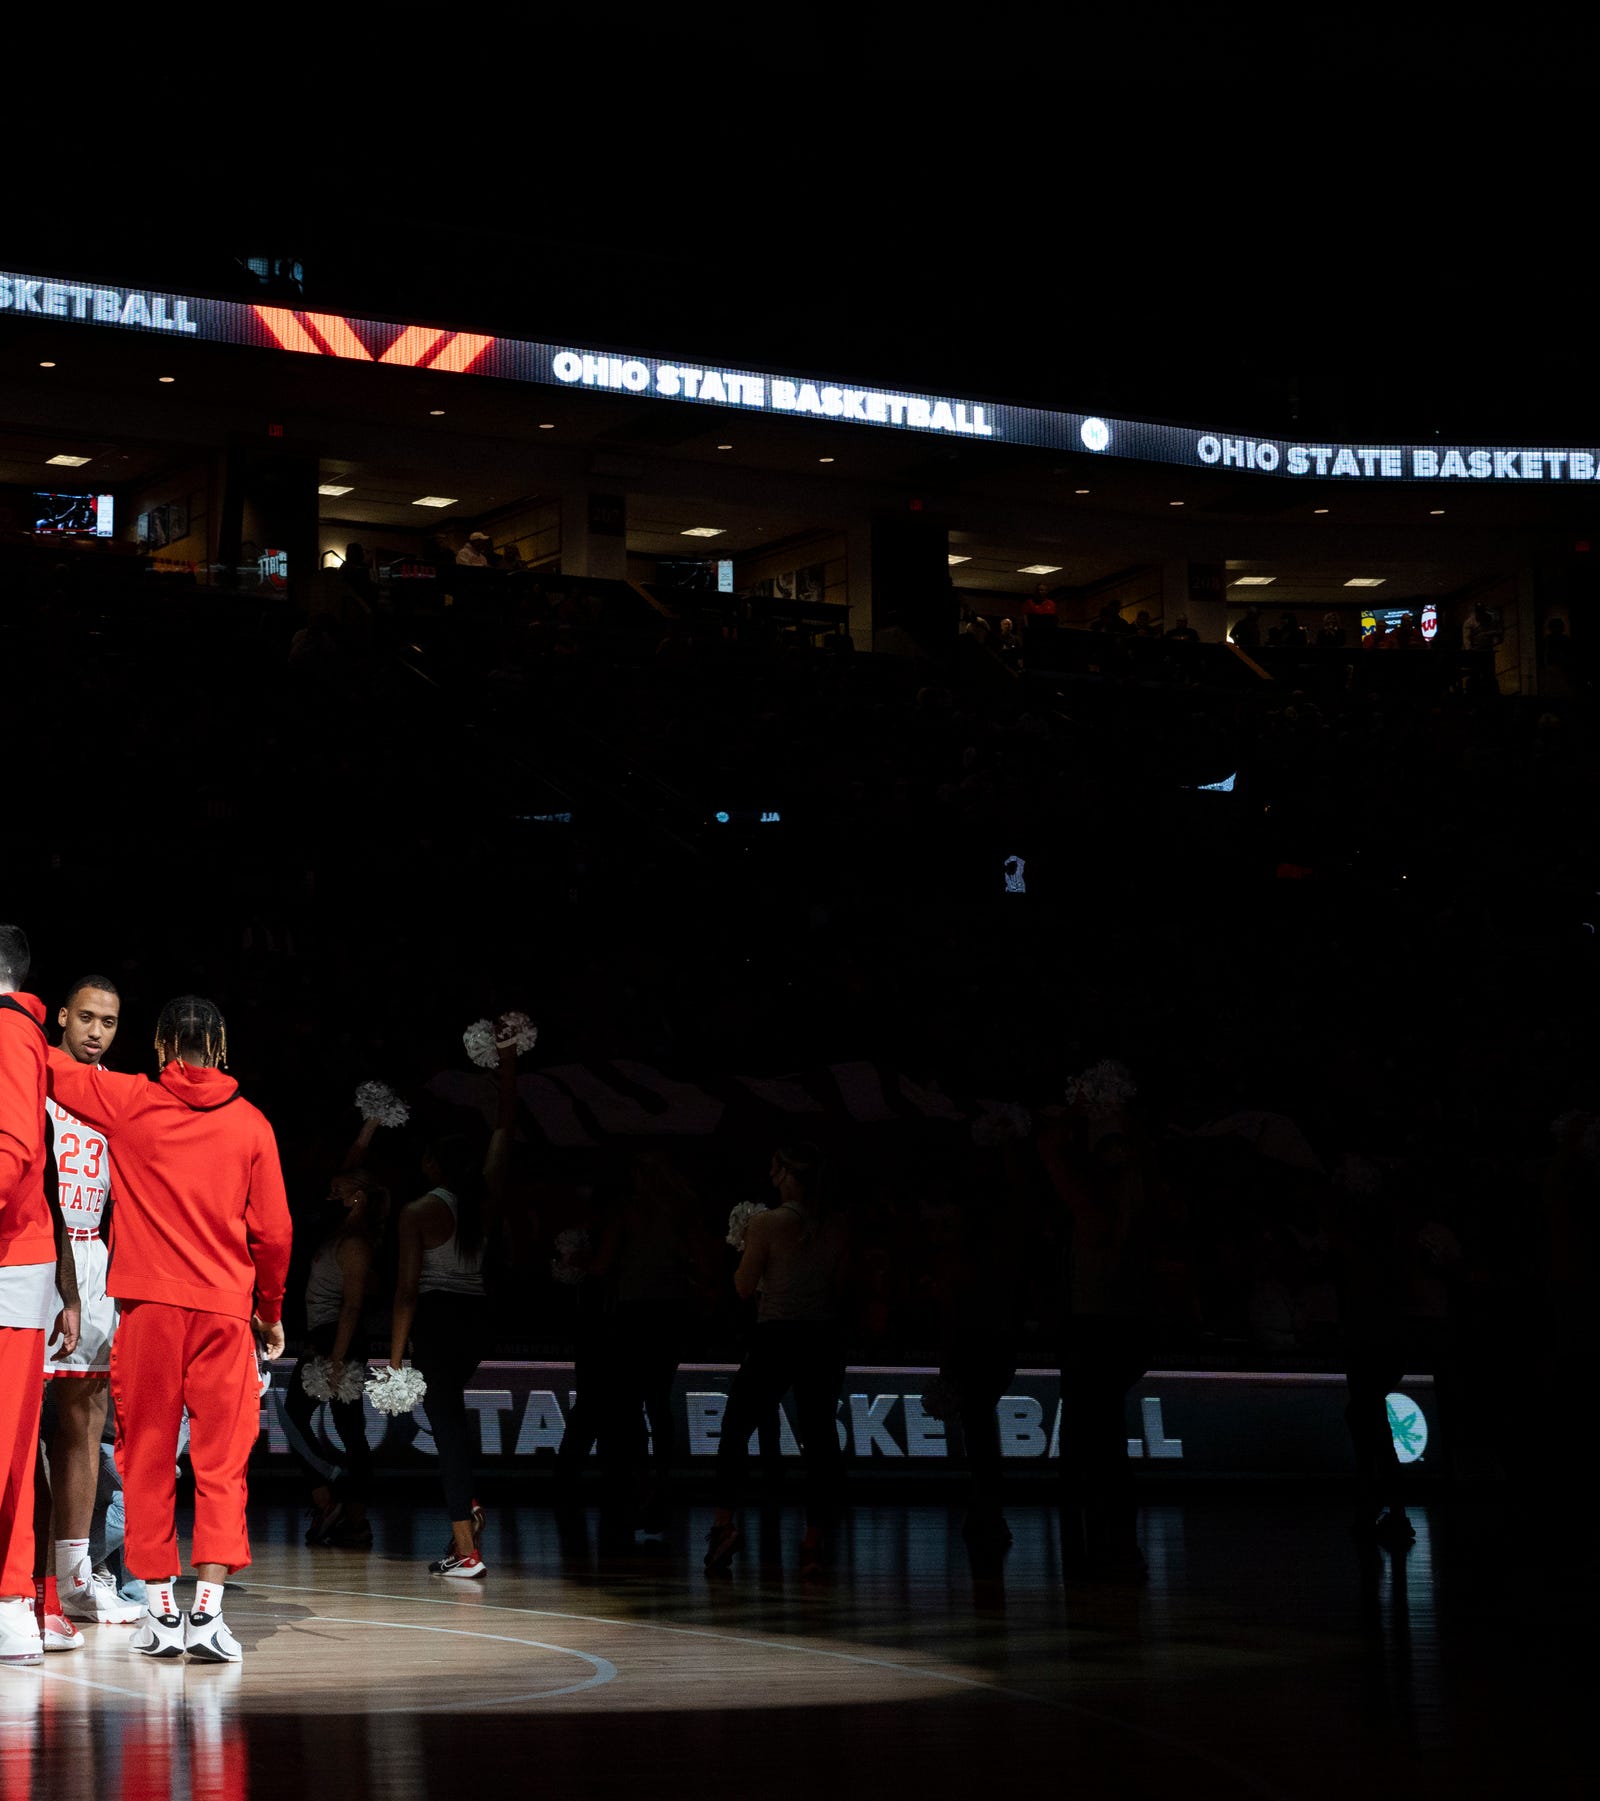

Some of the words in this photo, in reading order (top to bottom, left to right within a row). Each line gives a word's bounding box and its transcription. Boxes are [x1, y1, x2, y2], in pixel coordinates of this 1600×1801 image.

[552, 350, 651, 392] OHIO
[655, 364, 766, 407] STATE
[770, 379, 995, 438] BASKETBALL
[1197, 435, 1280, 472] OHIO
[1286, 446, 1402, 478] STATE
[1412, 449, 1600, 481] BASKETB
[58, 1131, 105, 1180] 23
[58, 1181, 105, 1214] TATE
